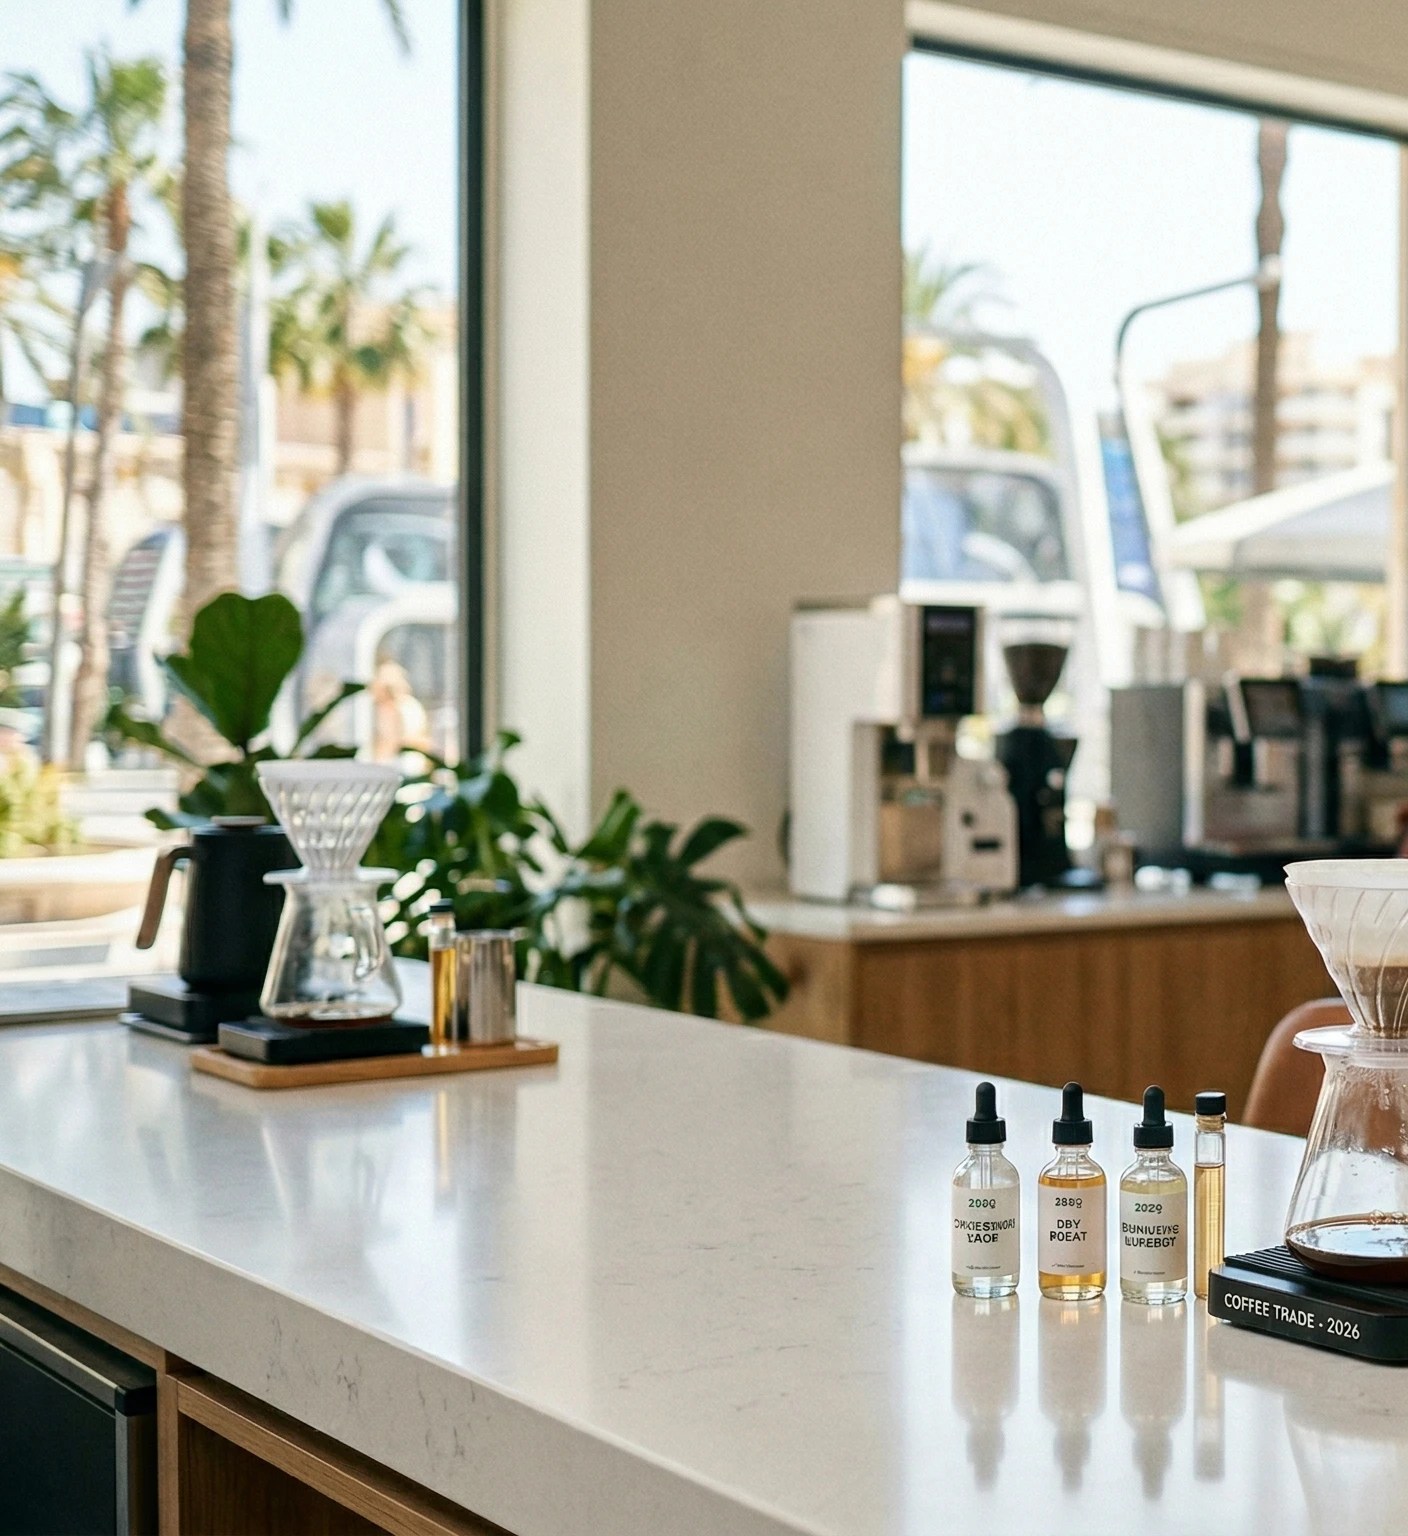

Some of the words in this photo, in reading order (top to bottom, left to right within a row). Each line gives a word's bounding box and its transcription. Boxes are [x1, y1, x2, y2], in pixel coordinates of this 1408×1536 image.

[1224, 1293, 1270, 1317] COFFEE
[1272, 1304, 1315, 1329] TRADE
[1327, 1317, 1360, 1340] 2026
